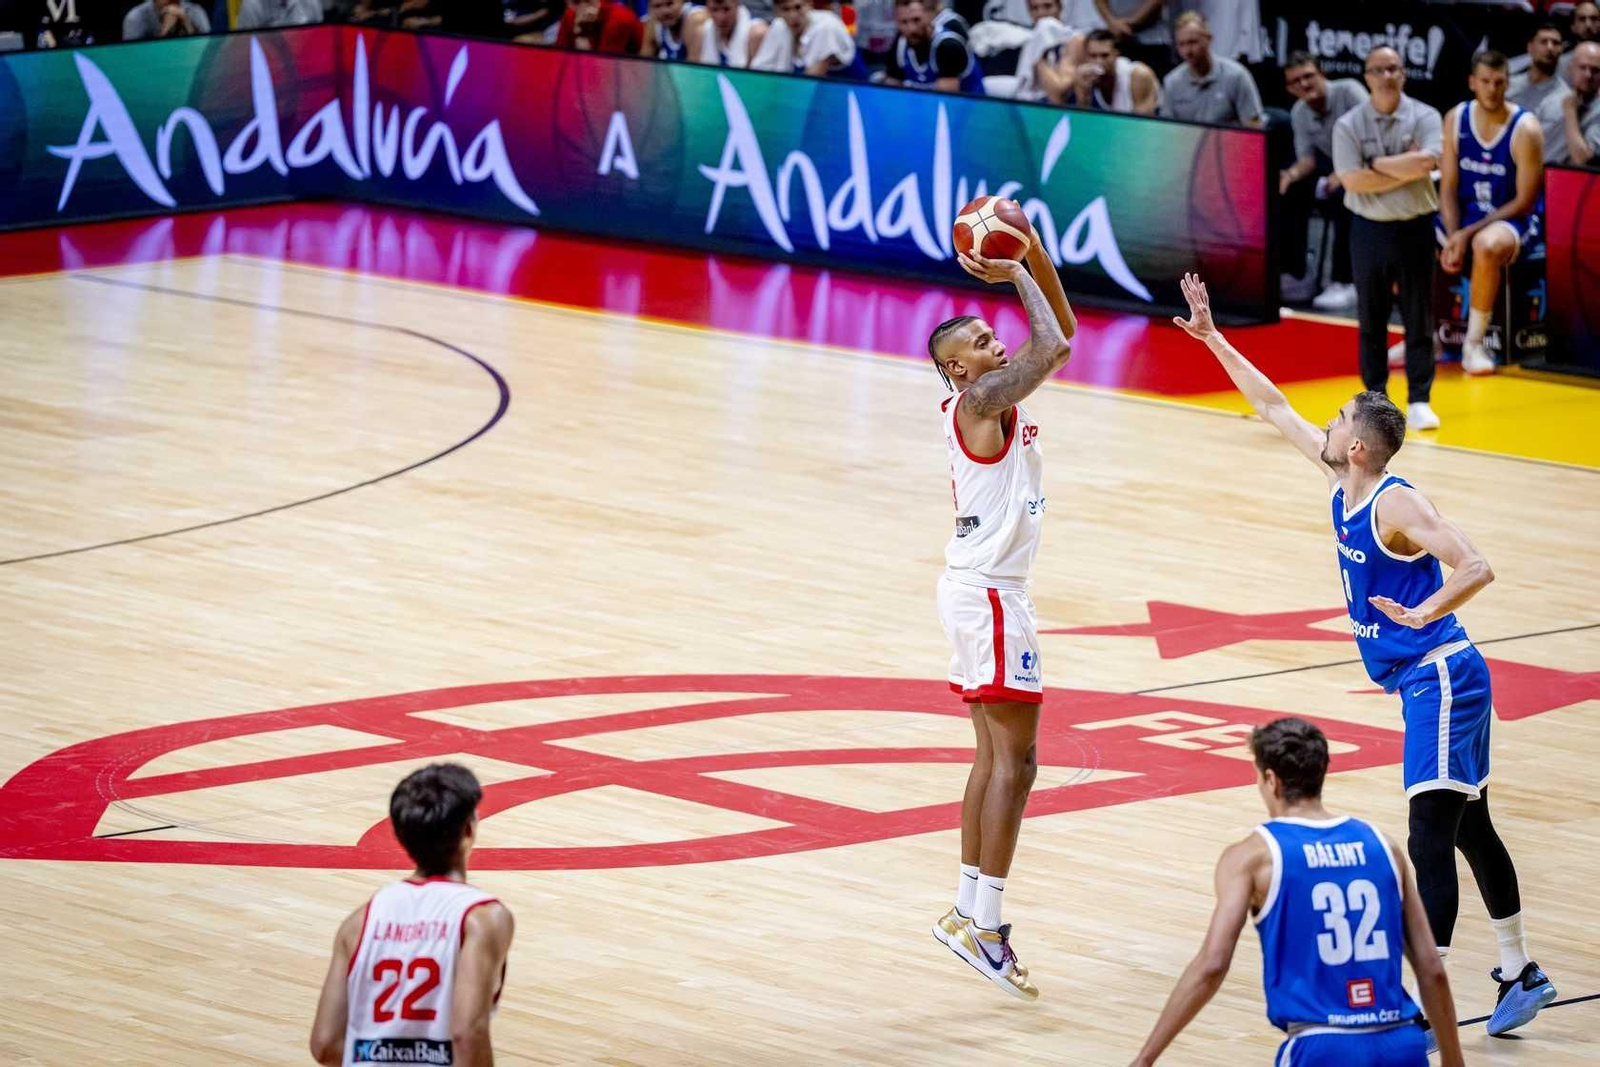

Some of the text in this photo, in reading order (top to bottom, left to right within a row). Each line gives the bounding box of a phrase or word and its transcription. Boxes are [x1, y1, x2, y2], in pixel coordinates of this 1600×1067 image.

[47, 32, 541, 216] Andalucía
[598, 110, 639, 180] A
[698, 73, 1154, 302] Andalía
[1303, 841, 1366, 869] BÁLINT
[1311, 879, 1389, 966] 32
[373, 957, 440, 1023] 22
[1328, 1009, 1400, 1026] SKUPINA ČEZ
[369, 1040, 450, 1065] CaixaBank
